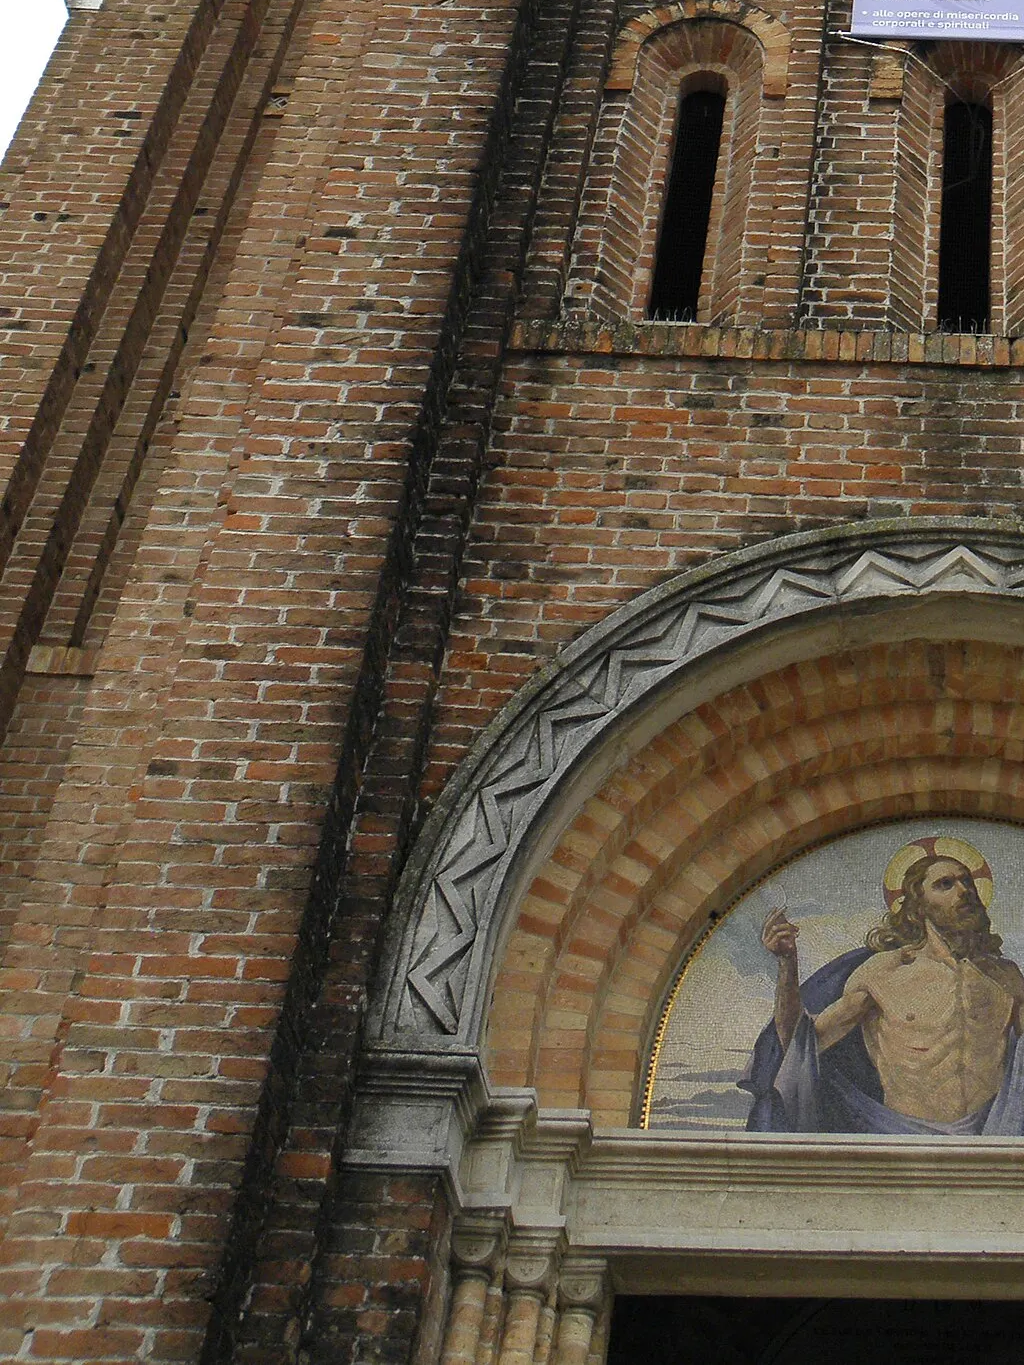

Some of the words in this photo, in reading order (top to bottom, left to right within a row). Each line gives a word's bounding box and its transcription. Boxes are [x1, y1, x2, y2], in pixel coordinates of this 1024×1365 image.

[896, 10, 931, 19] opere
[933, 10, 943, 18] di
[946, 11, 1019, 21] misericordia
[872, 19, 925, 28] corporali
[937, 20, 989, 30] spirituali
